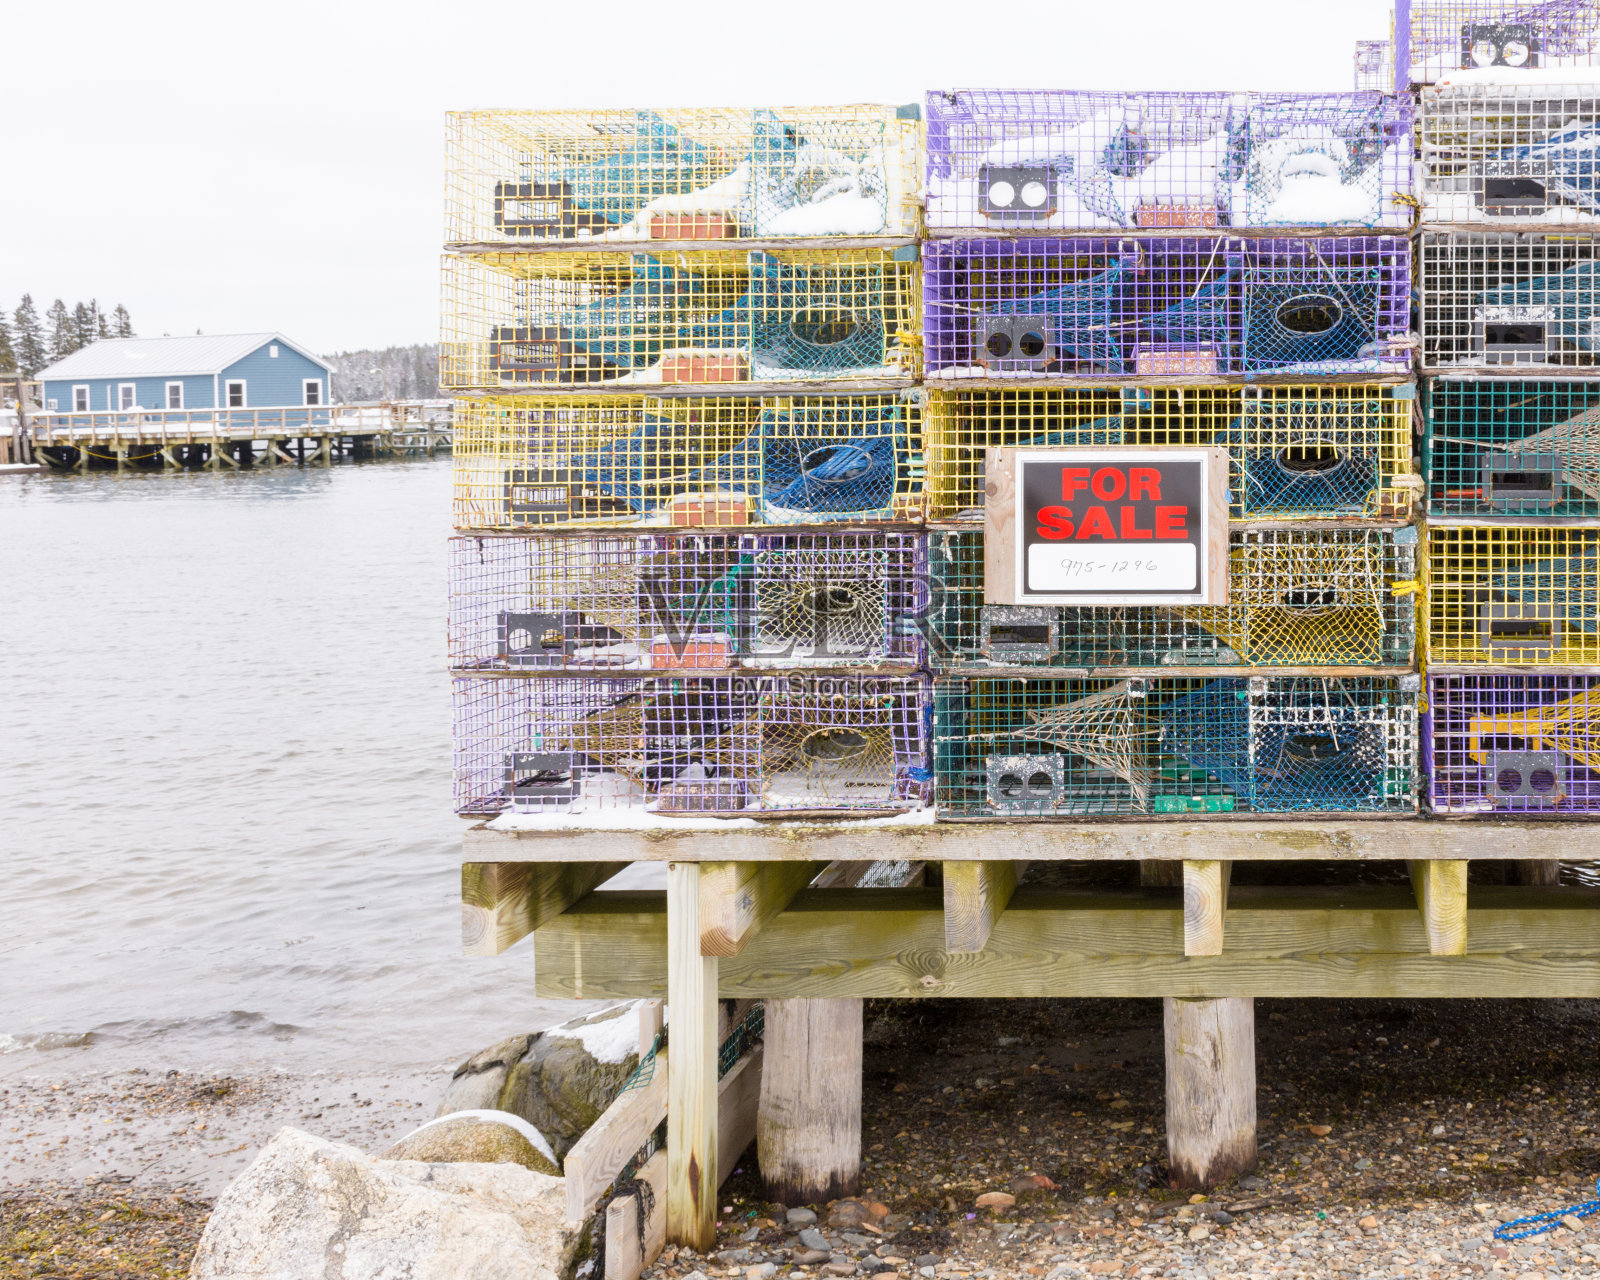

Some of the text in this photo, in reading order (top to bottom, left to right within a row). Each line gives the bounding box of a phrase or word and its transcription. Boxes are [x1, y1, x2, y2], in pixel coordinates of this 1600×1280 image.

[1062, 467, 1162, 501] FOR
[1036, 505, 1189, 540] SALE
[1060, 558, 1159, 577] 975-1296
